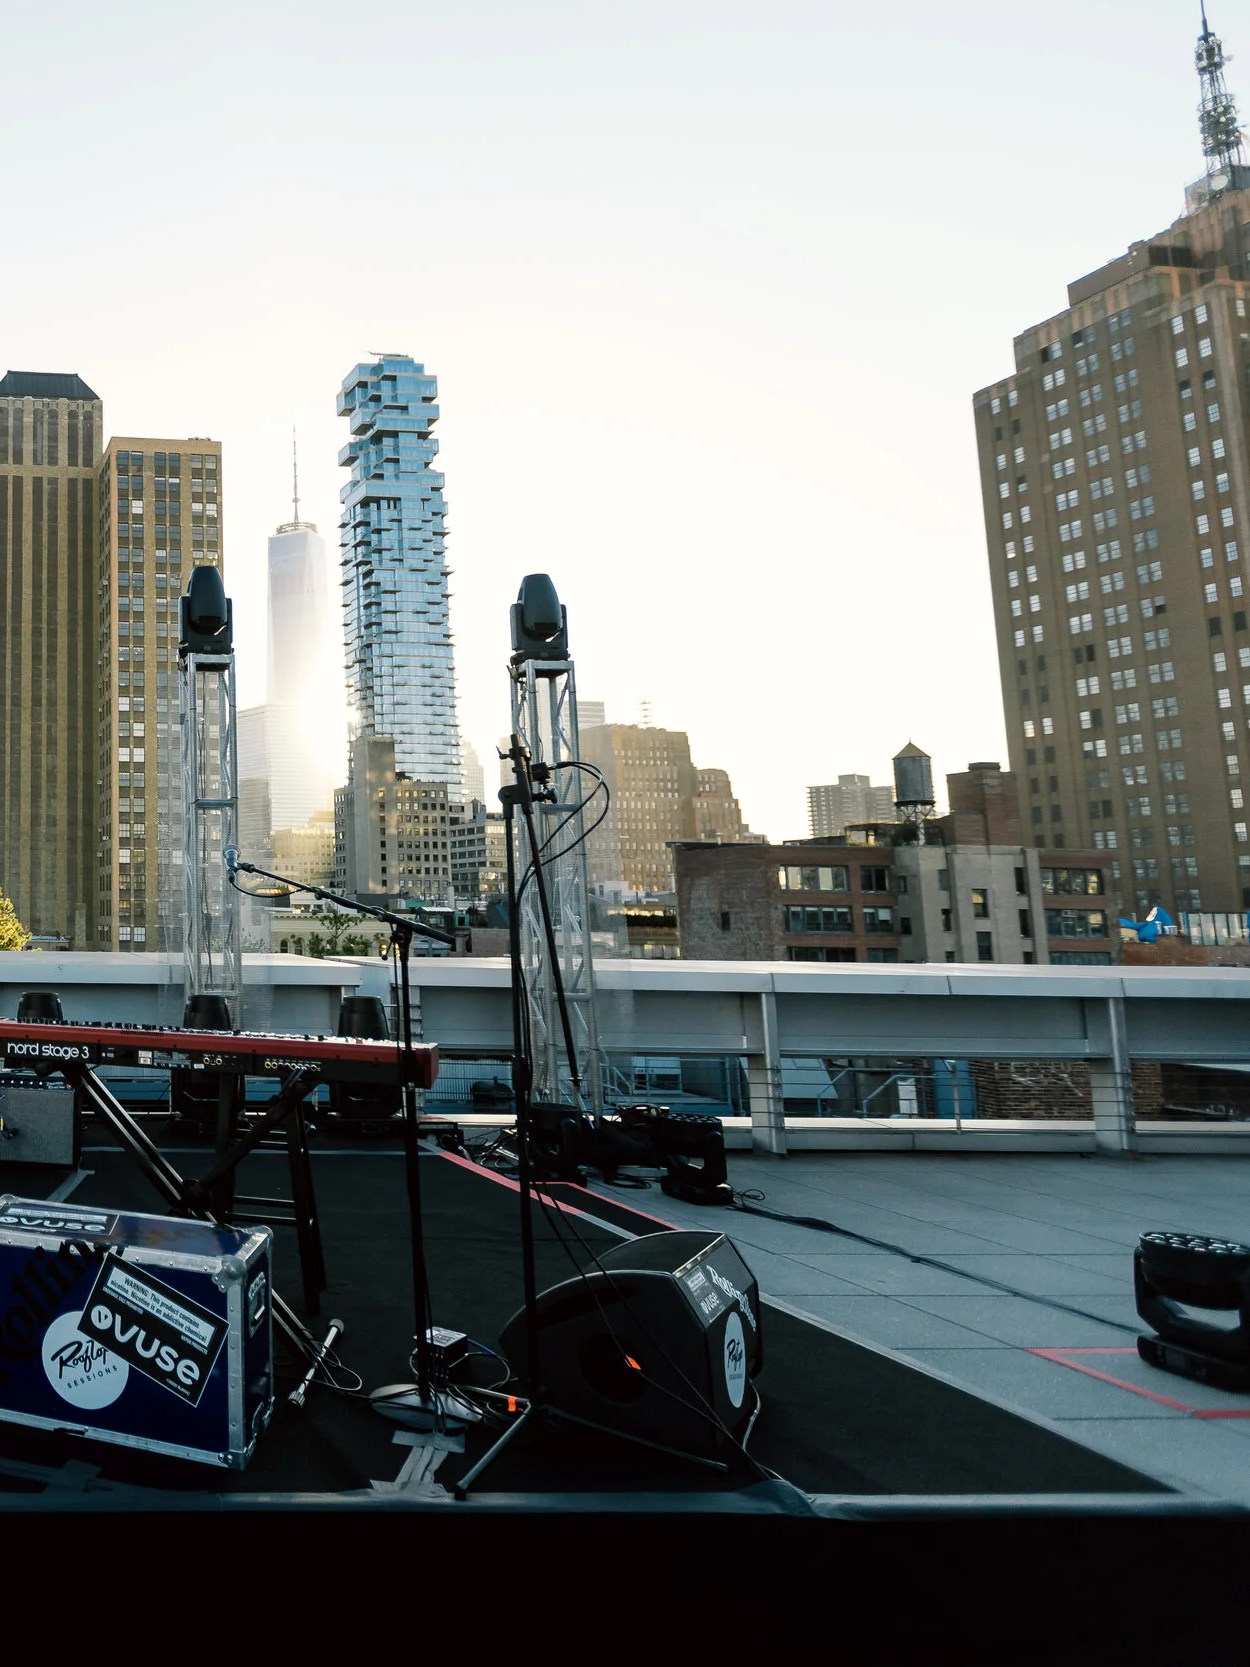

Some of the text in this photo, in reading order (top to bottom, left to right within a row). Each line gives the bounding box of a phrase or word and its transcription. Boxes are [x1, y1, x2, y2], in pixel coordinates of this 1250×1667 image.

[7, 1043, 39, 1055] nord
[42, 1044, 79, 1060] stage
[81, 1045, 89, 1059] 3
[67, 1365, 118, 1389] SESSIONS
